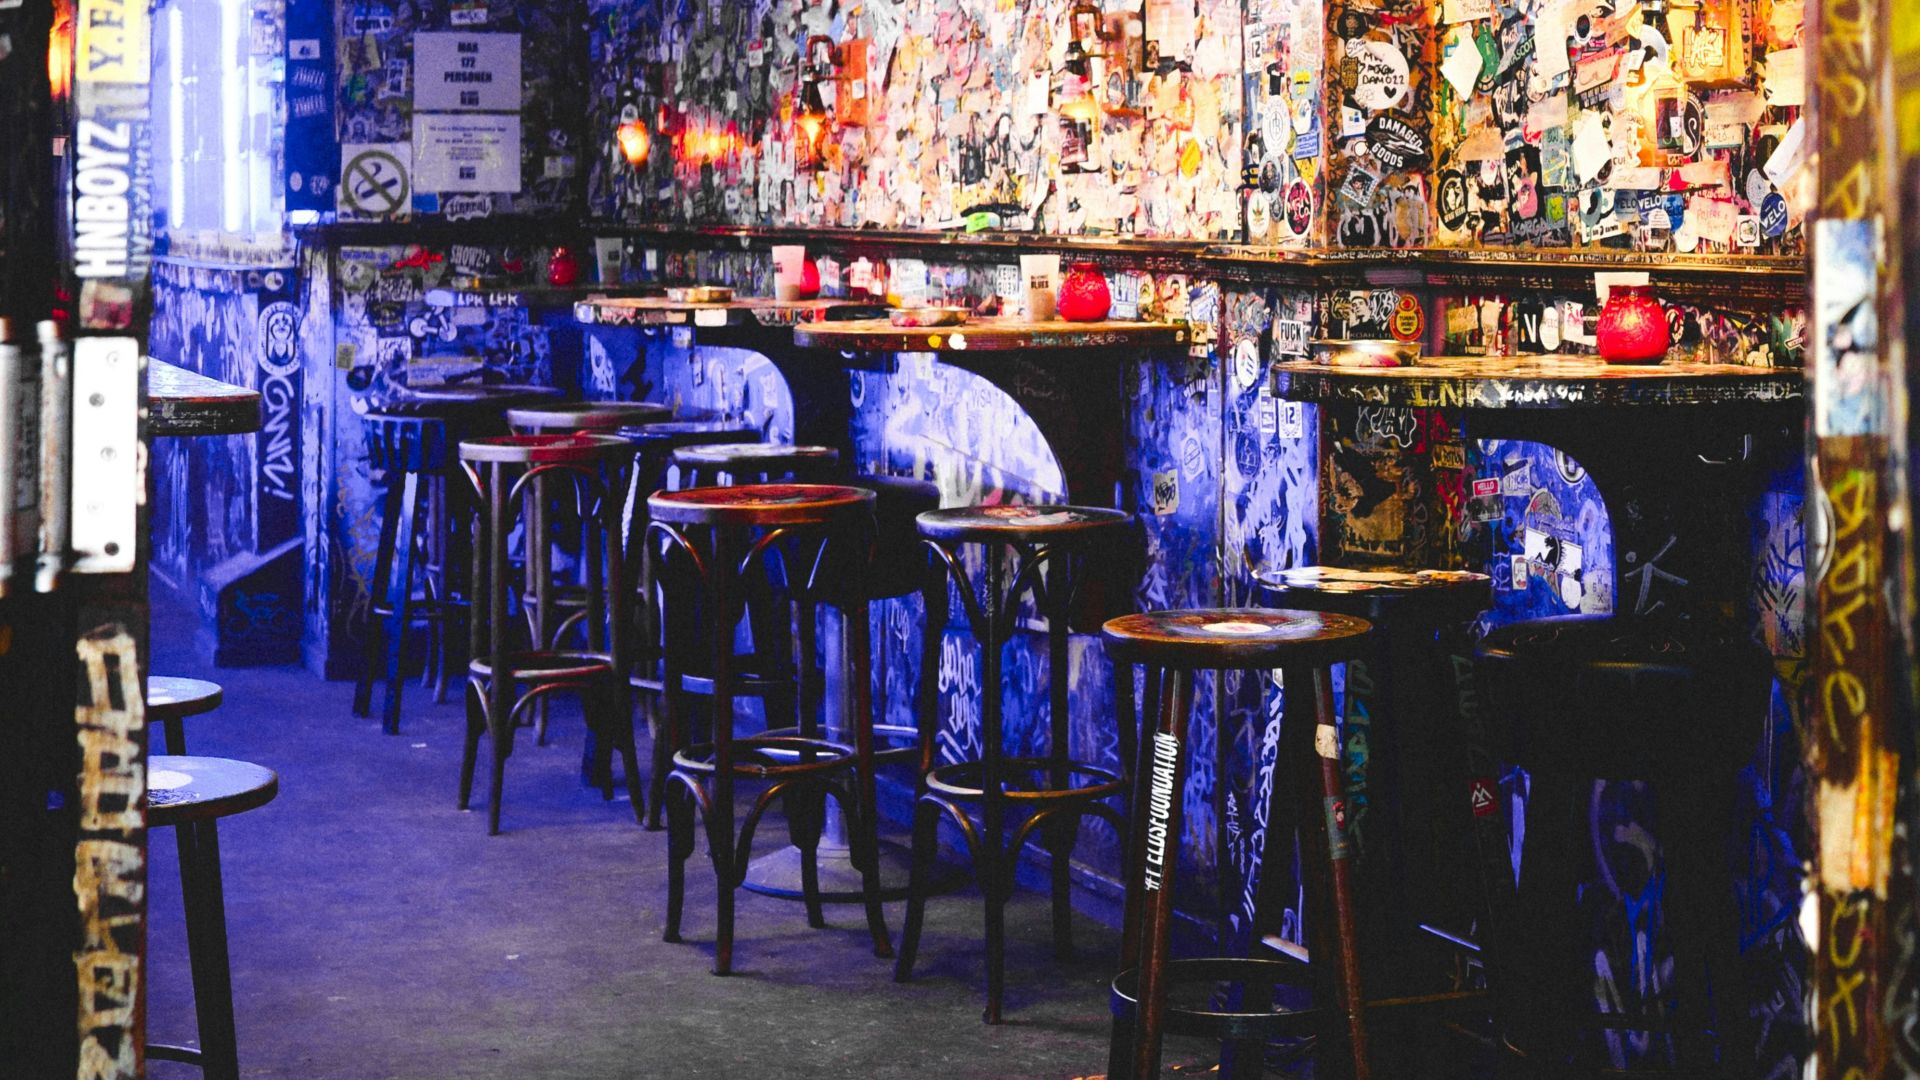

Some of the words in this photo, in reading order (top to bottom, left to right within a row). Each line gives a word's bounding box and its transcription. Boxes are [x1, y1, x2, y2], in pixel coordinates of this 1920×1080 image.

[444, 71, 492, 83] PERSONEN
[1378, 116, 1424, 149] DAMAGED
[1371, 142, 1404, 168] GOODS
[1638, 194, 1663, 211] VELO
[1760, 200, 1786, 230] VELO
[1280, 322, 1303, 342] FUCK
[1285, 406, 1295, 425] 12
[1477, 481, 1495, 491] HELLO
